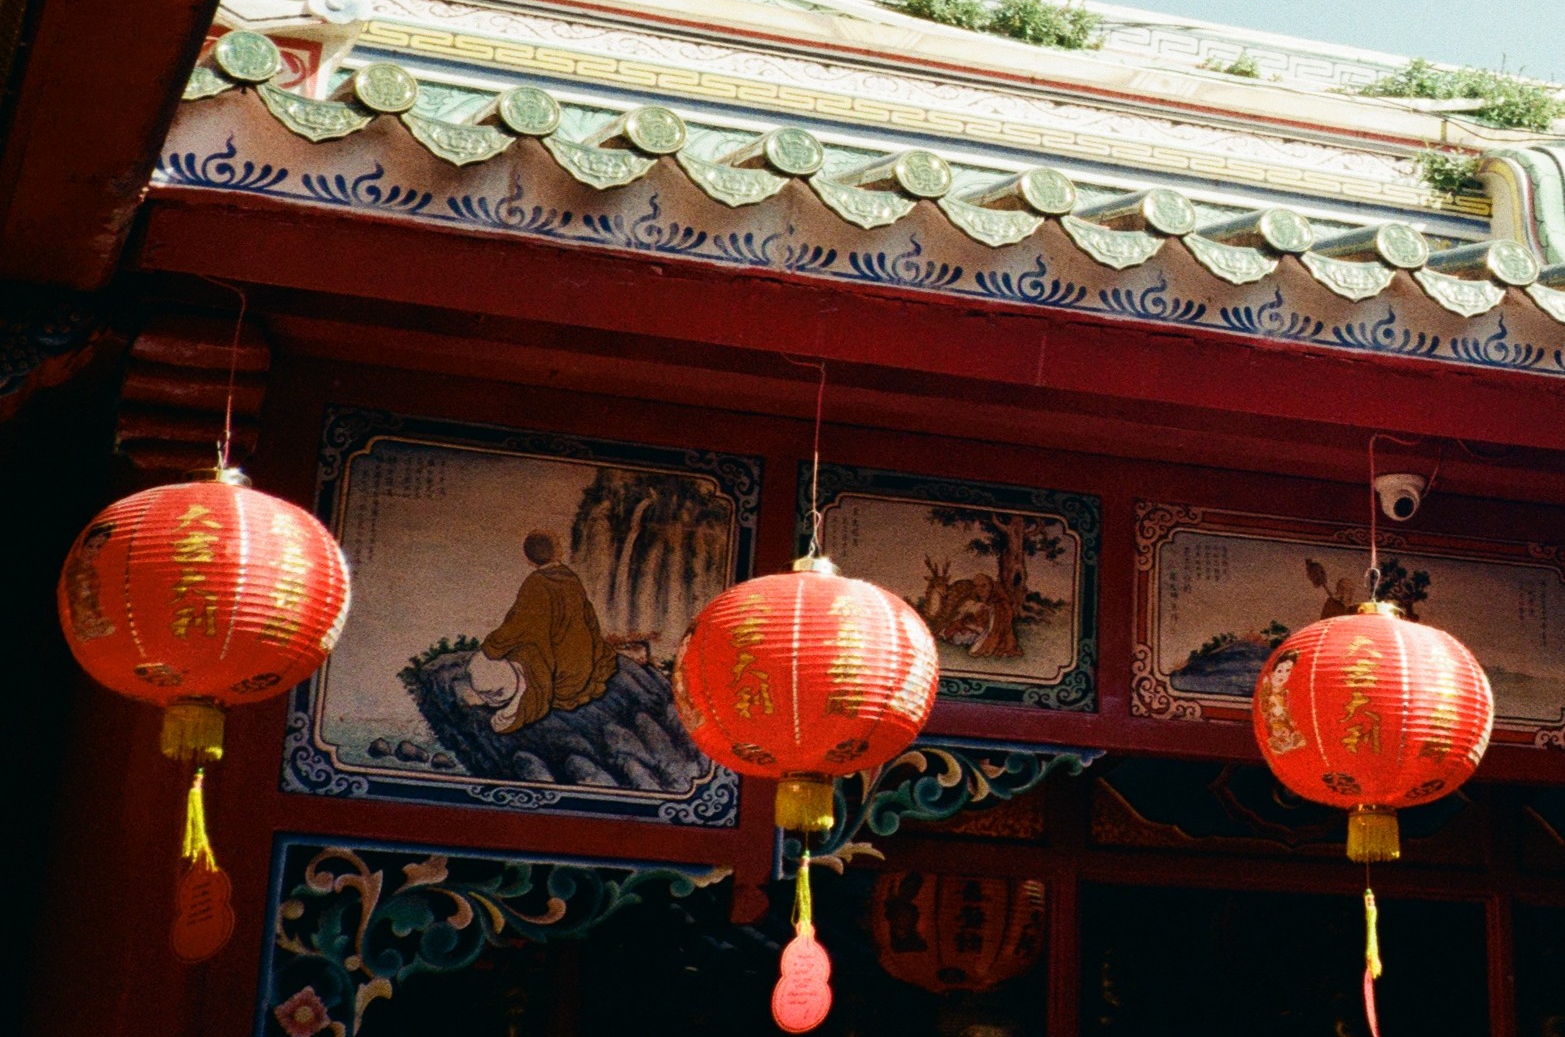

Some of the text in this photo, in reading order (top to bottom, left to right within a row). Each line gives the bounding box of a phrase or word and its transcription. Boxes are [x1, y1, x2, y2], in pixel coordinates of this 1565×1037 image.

[170, 504, 223, 641] 大吉大利
[727, 593, 775, 720] 大吉大利
[1339, 635, 1385, 756] 大吉大利
